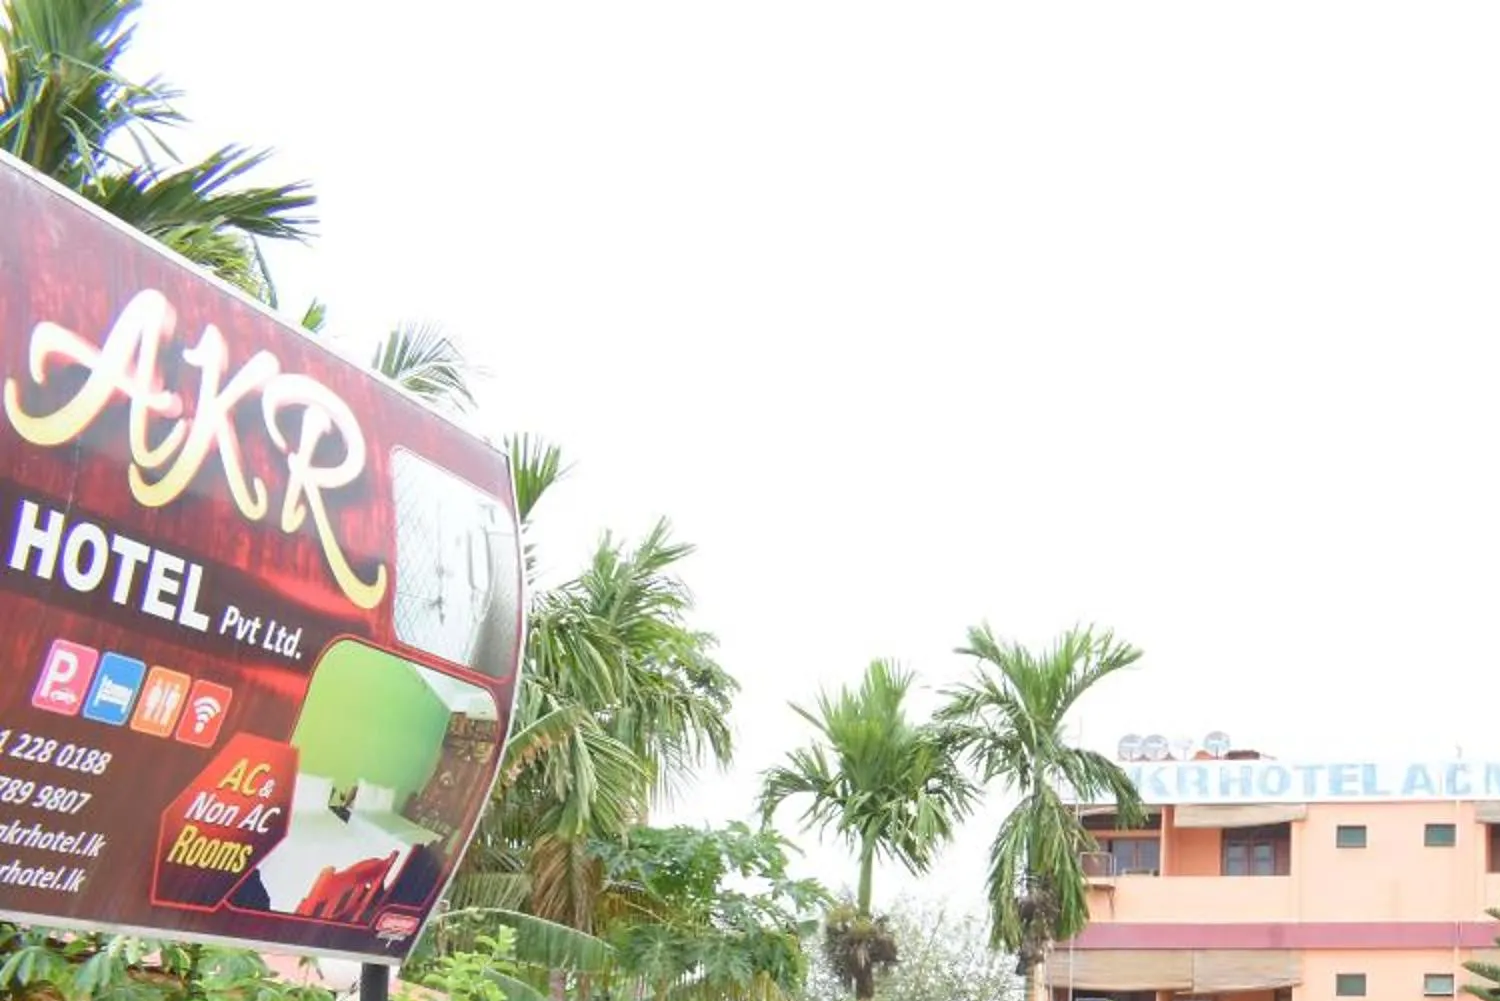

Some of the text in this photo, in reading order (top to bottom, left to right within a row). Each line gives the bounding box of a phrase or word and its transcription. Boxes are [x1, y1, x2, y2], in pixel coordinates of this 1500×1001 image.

[4, 288, 387, 610] AKR
[8, 499, 304, 661] HOTEL Pvt Ltd.
[9, 732, 59, 763] 228
[55, 744, 113, 776] 0188
[31, 784, 93, 816] 9807
[216, 758, 276, 799] AC &
[184, 791, 282, 833] Non AC
[166, 824, 254, 874] Rooms
